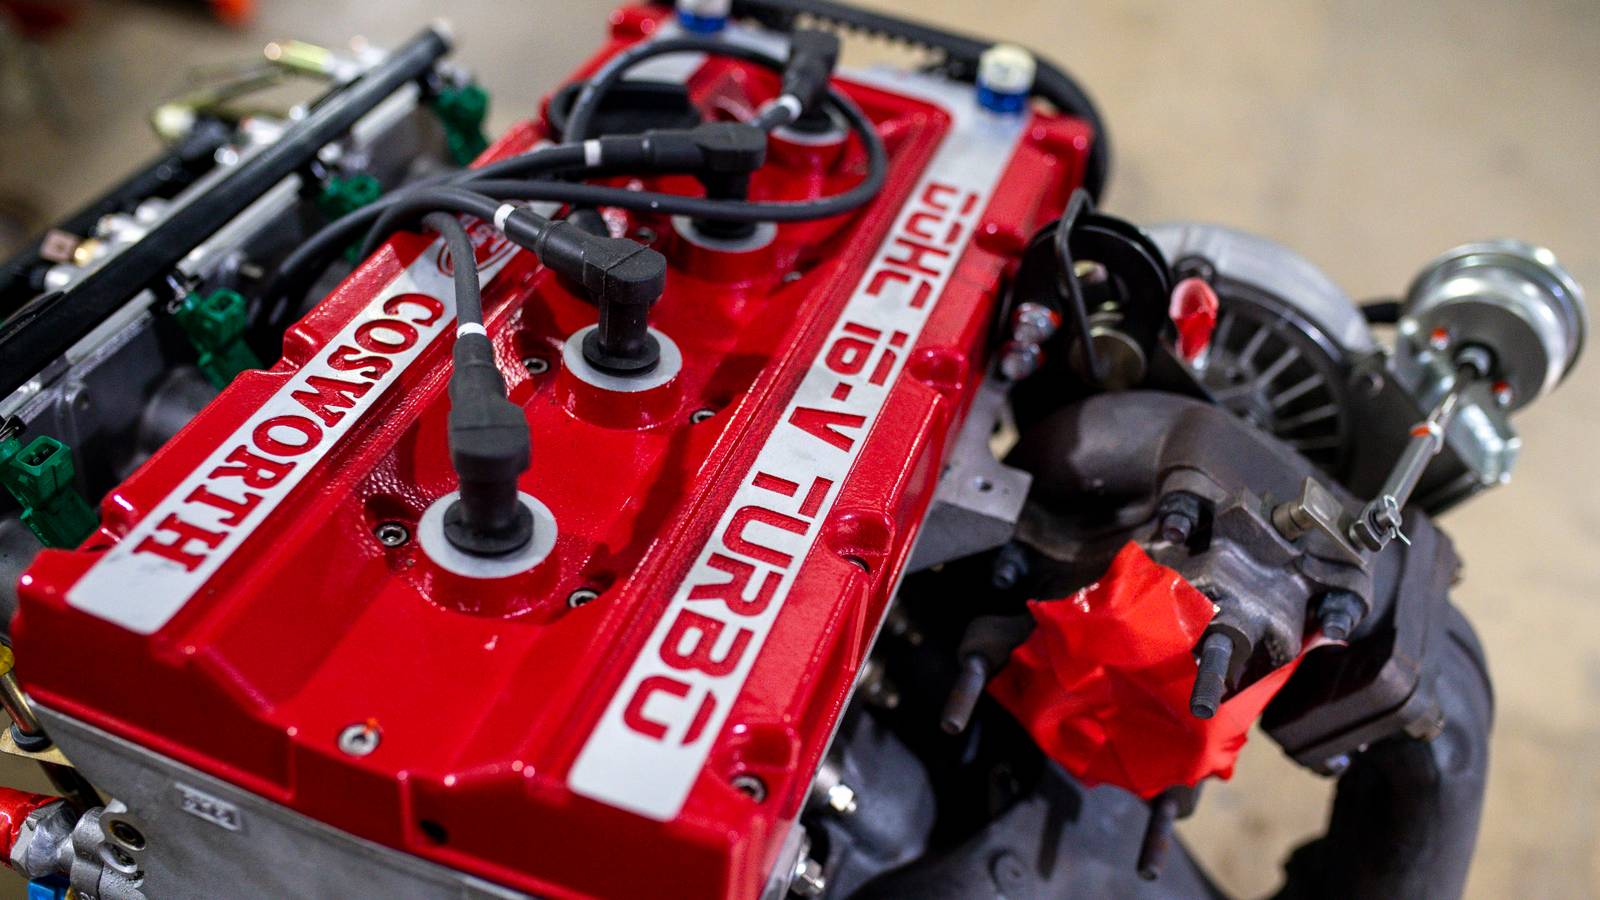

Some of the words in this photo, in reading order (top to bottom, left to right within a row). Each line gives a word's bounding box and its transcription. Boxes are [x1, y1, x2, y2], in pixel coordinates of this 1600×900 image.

[864, 183, 978, 310] DOHC
[132, 292, 444, 573] COSWORTH
[788, 321, 909, 453] 16-V
[623, 471, 834, 747] TURBO
